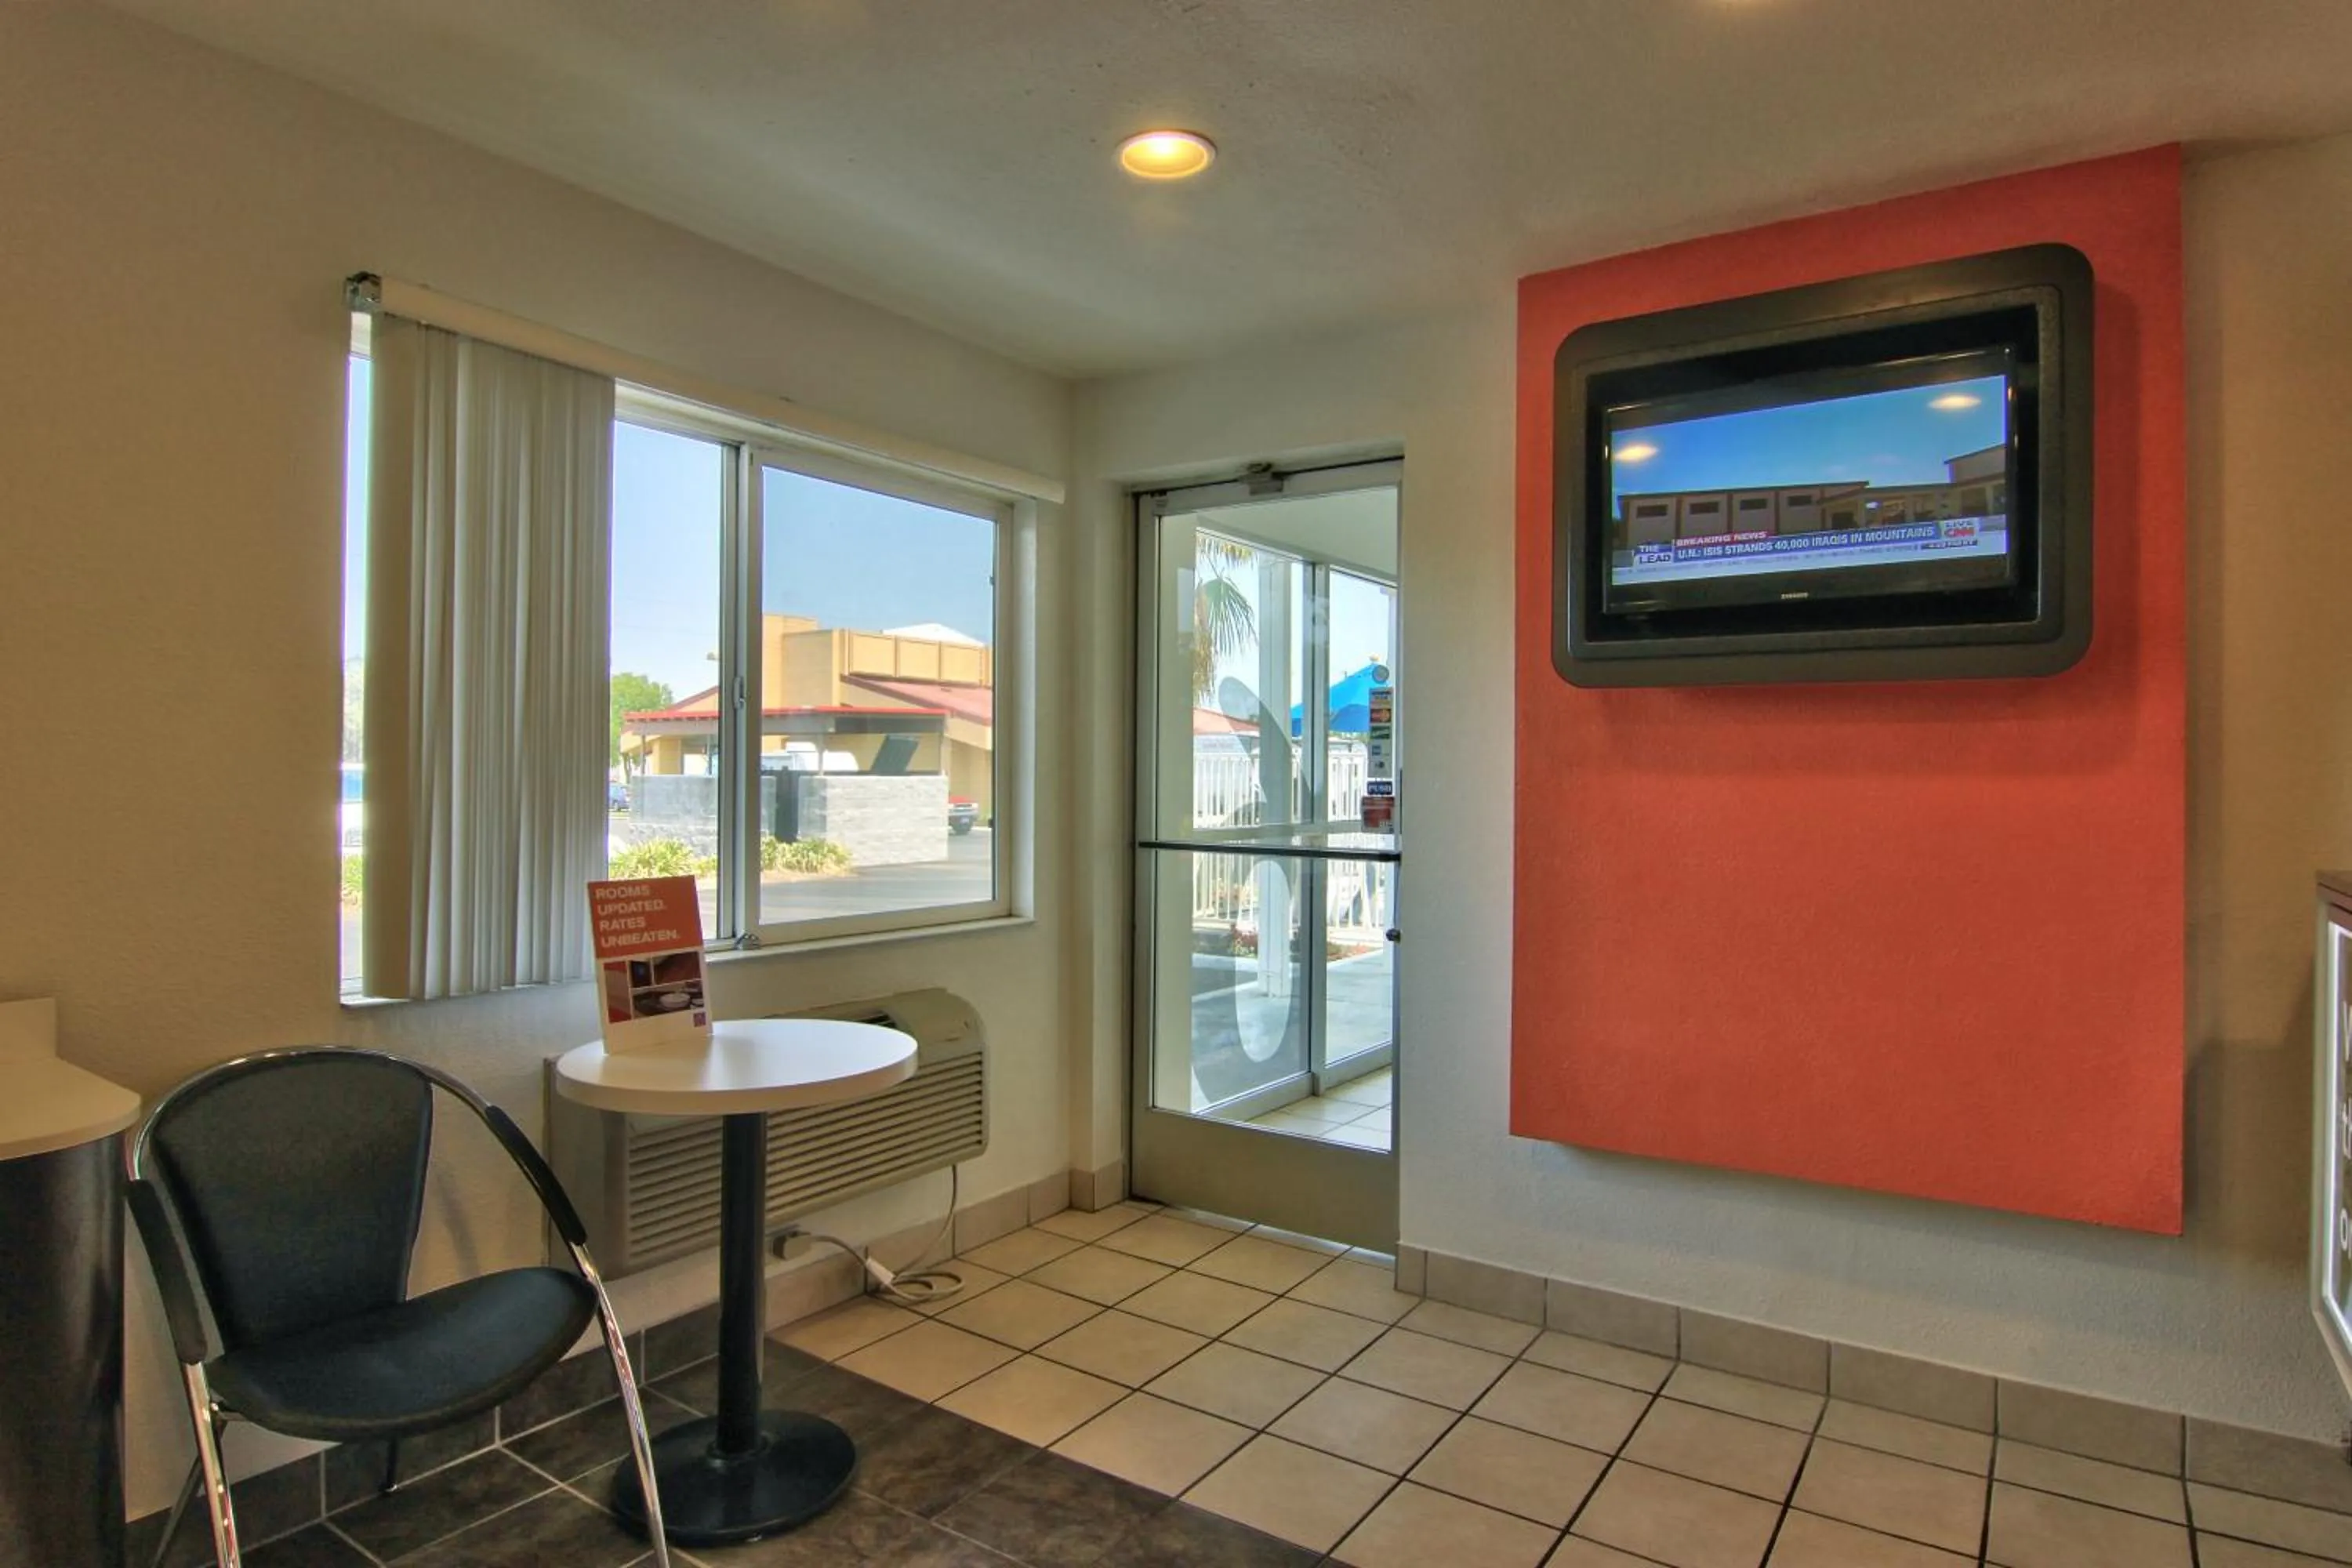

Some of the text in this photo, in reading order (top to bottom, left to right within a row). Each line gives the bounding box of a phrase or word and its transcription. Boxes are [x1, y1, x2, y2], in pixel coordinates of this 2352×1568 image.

[1676, 531, 1767, 546] BREAKING NEWS
[1704, 546, 1722, 557] ISIS
[1726, 542, 1773, 554] STRANDS
[1774, 539, 1809, 550] 40,000
[1812, 534, 1848, 546] IRAQIS
[1851, 532, 1863, 543] IN
[1865, 526, 1934, 542] MOUNTAINS
[1639, 554, 1671, 564] LEAD
[597, 900, 666, 916] UPDATED.
[600, 917, 646, 931] RATES
[601, 929, 681, 948] UNBEATEN.
